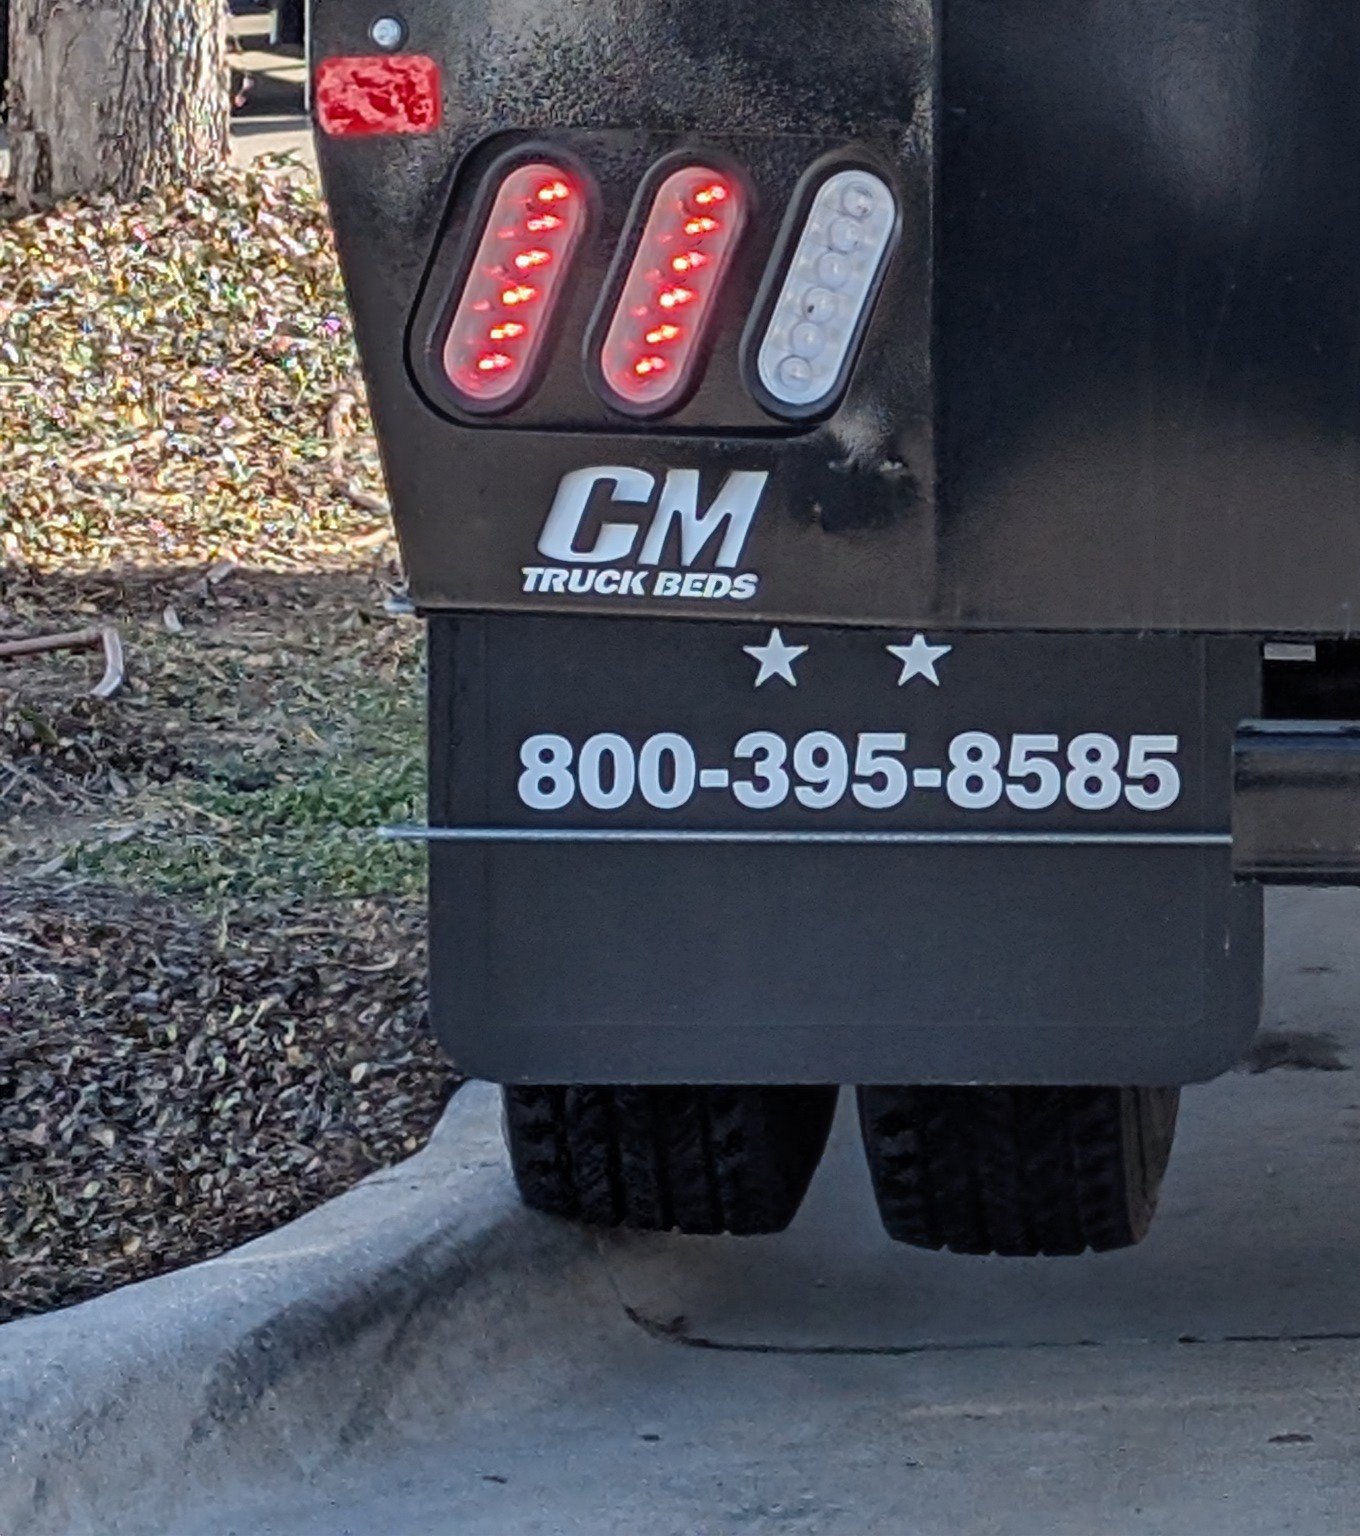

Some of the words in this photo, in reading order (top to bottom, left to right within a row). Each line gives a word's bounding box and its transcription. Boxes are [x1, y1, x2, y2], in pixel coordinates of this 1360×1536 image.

[537, 466, 769, 568] CM
[521, 567, 649, 596] TRUCK
[652, 572, 759, 600] BEDS
[517, 730, 1182, 812] 800-395-8585
